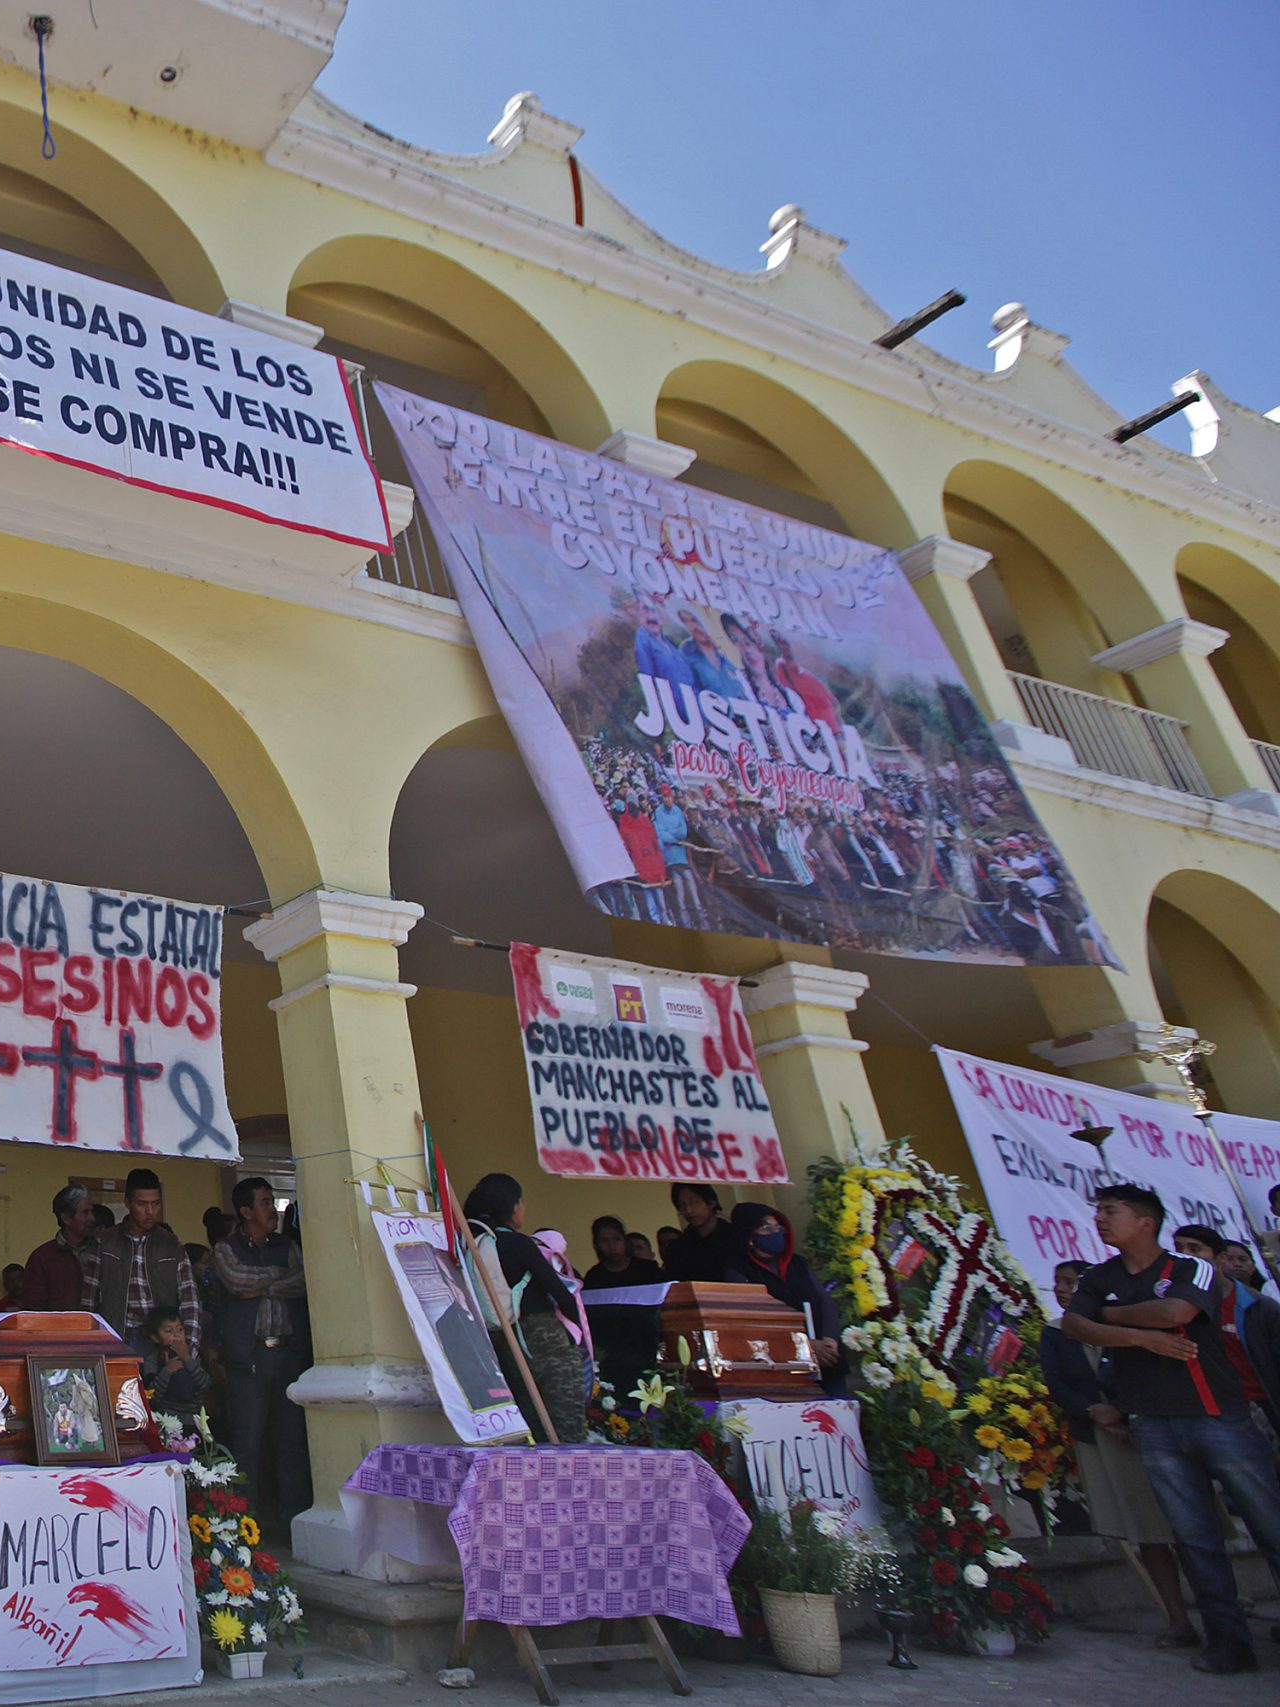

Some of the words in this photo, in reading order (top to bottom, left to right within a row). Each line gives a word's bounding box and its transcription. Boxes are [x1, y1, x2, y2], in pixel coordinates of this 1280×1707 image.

[161, 326, 220, 373] DE
[231, 347, 314, 398] LOS
[71, 347, 122, 391] NI
[136, 366, 194, 410] SE
[203, 384, 353, 455] VENDE
[60, 395, 301, 495] COMPRA!!!
[504, 432, 566, 484] LA
[578, 454, 662, 512] PAZ
[616, 506, 663, 555] EL
[670, 517, 822, 599] PUEBLO
[550, 526, 844, 642] COYOMEAPAN
[634, 673, 881, 790] JUSTICIA
[673, 740, 730, 786] para
[89, 890, 225, 978] ESTATAL
[618, 999, 643, 1022] PT
[665, 1000, 704, 1016] morena
[526, 1021, 690, 1066] GOBERNADOR
[531, 1060, 720, 1109] MANCHASTES
[732, 1075, 770, 1111] AL
[540, 1106, 662, 1152] PUEBLO
[674, 1115, 719, 1159] DE
[599, 1124, 747, 1179] SANGRE
[1120, 1113, 1172, 1159] POR
[1028, 1214, 1085, 1261] POR
